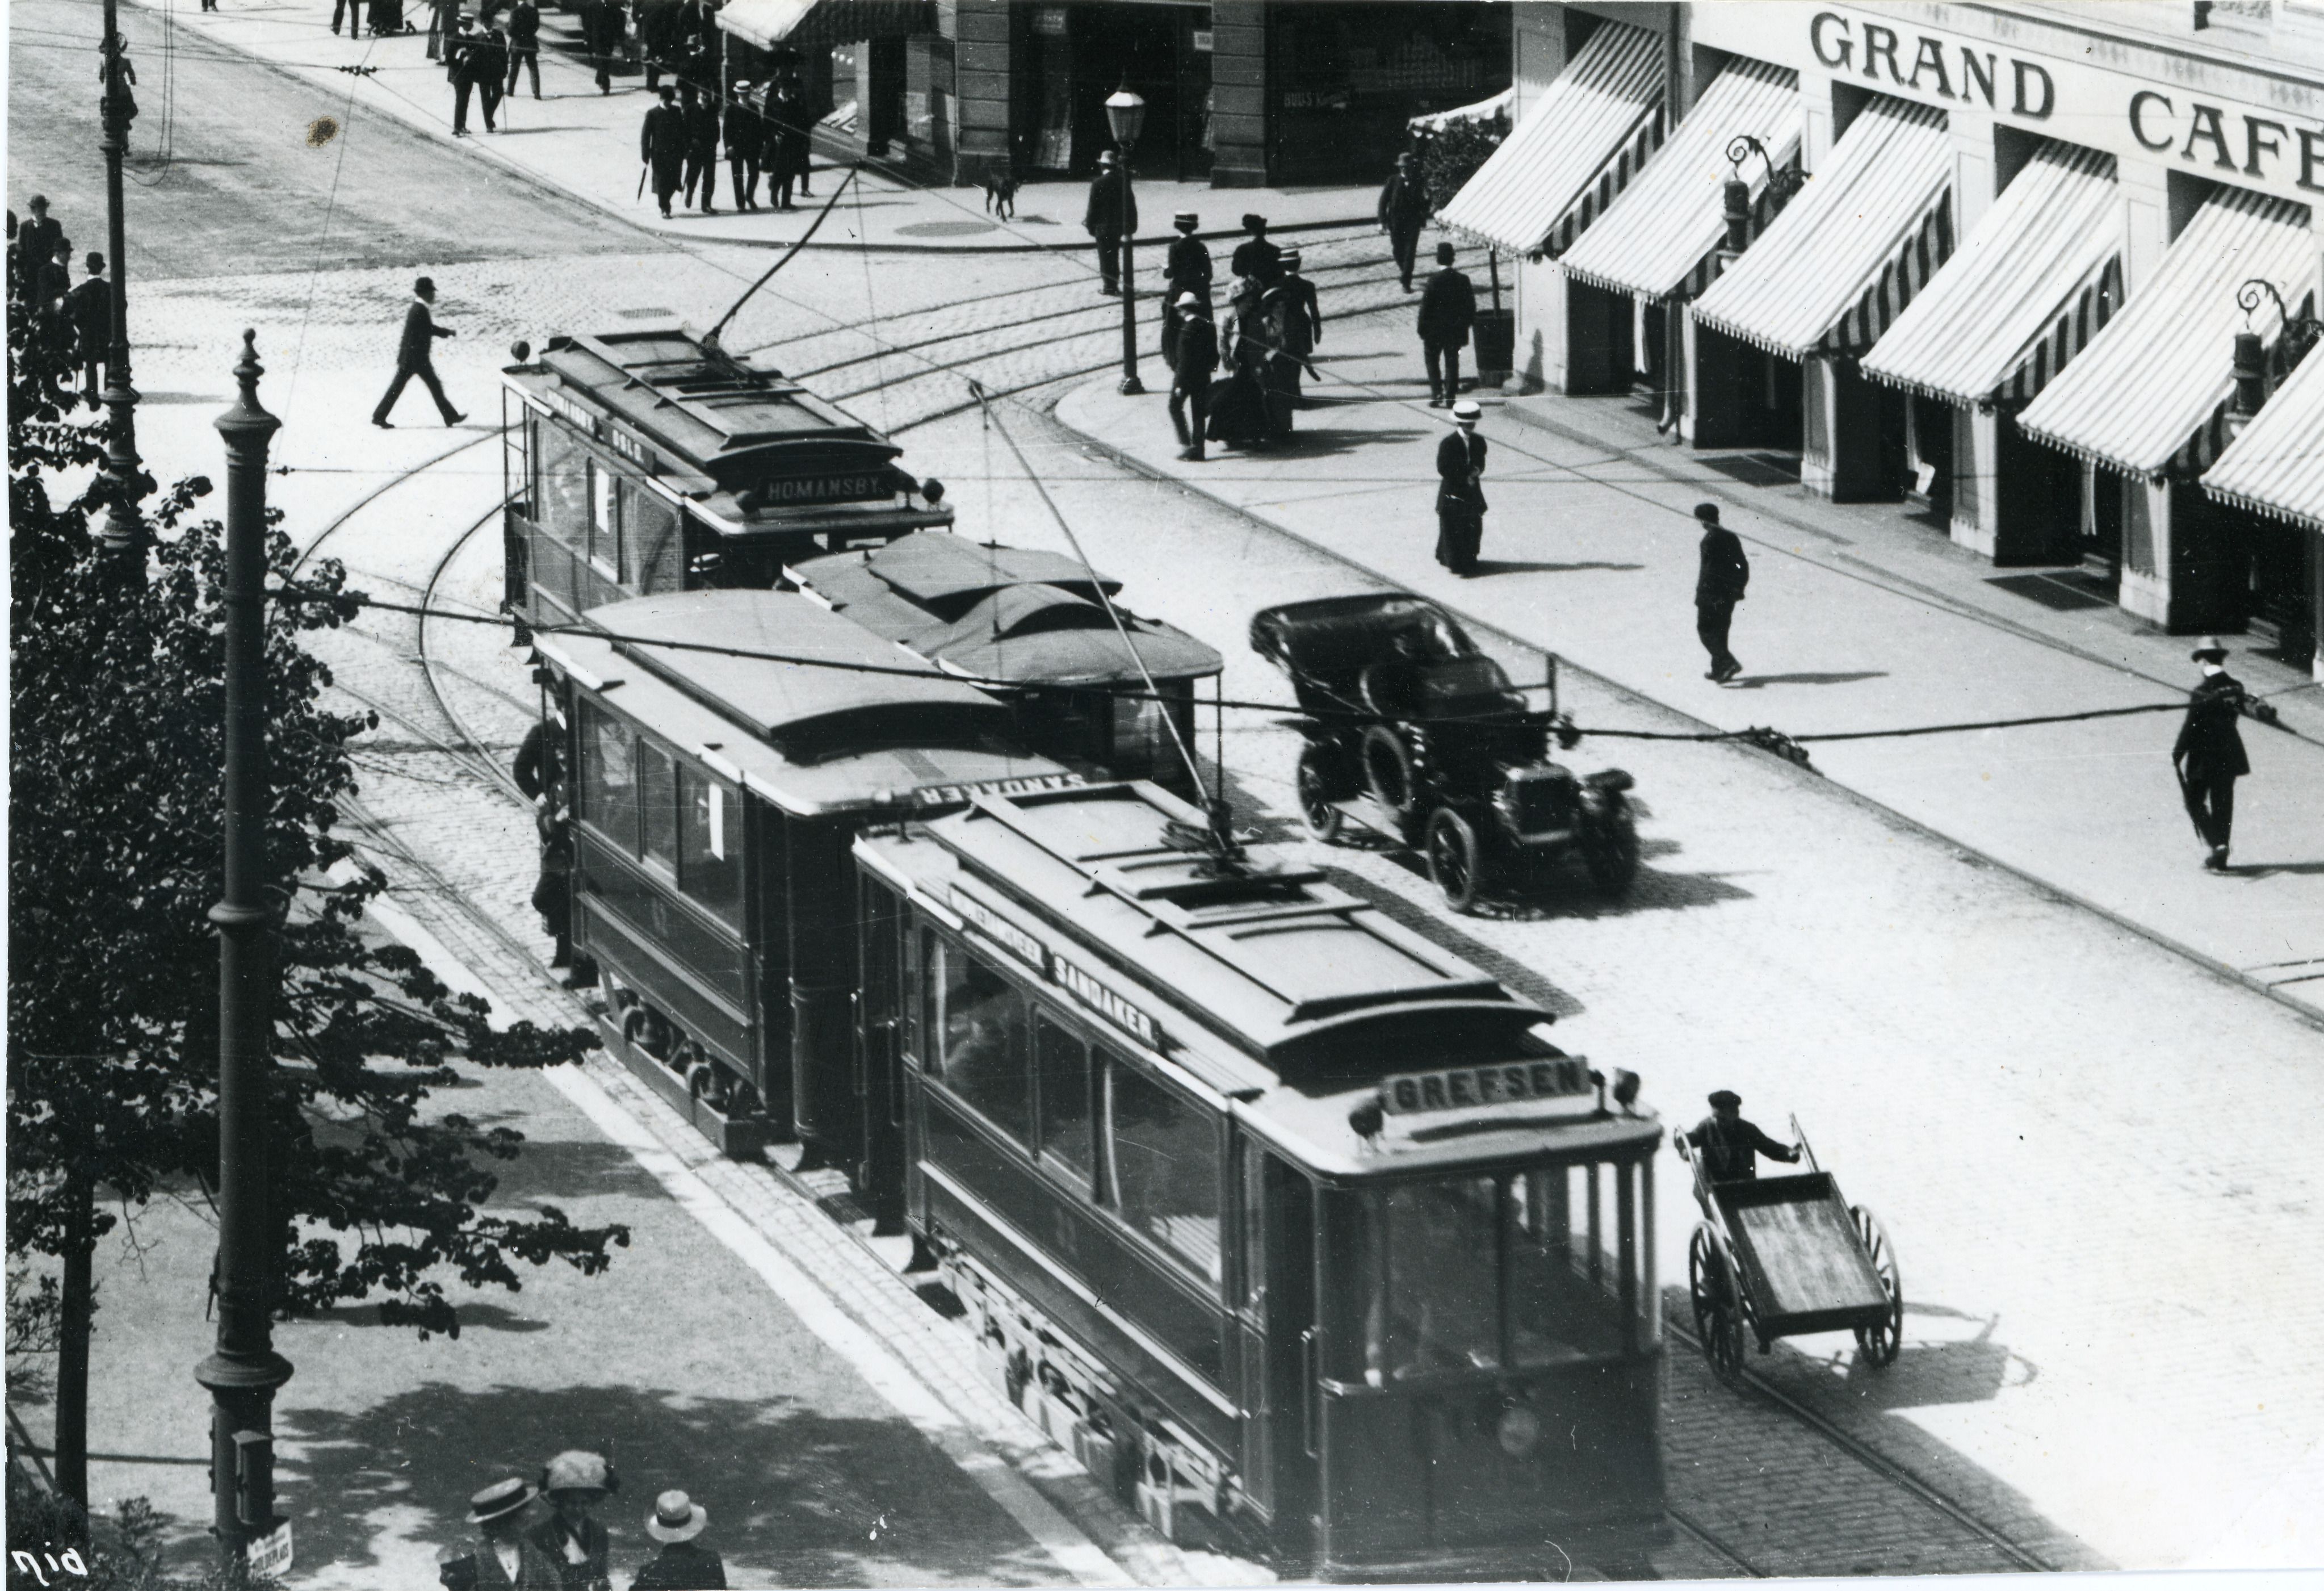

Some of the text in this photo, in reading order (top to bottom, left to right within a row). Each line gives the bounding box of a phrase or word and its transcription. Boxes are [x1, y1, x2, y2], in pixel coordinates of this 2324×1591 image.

[1810, 11, 2055, 121] GRAND
[767, 474, 880, 501] HOMANSBY
[1053, 953, 1155, 1047] SANDAKER
[1394, 1060, 1582, 1110] GREFSEN
